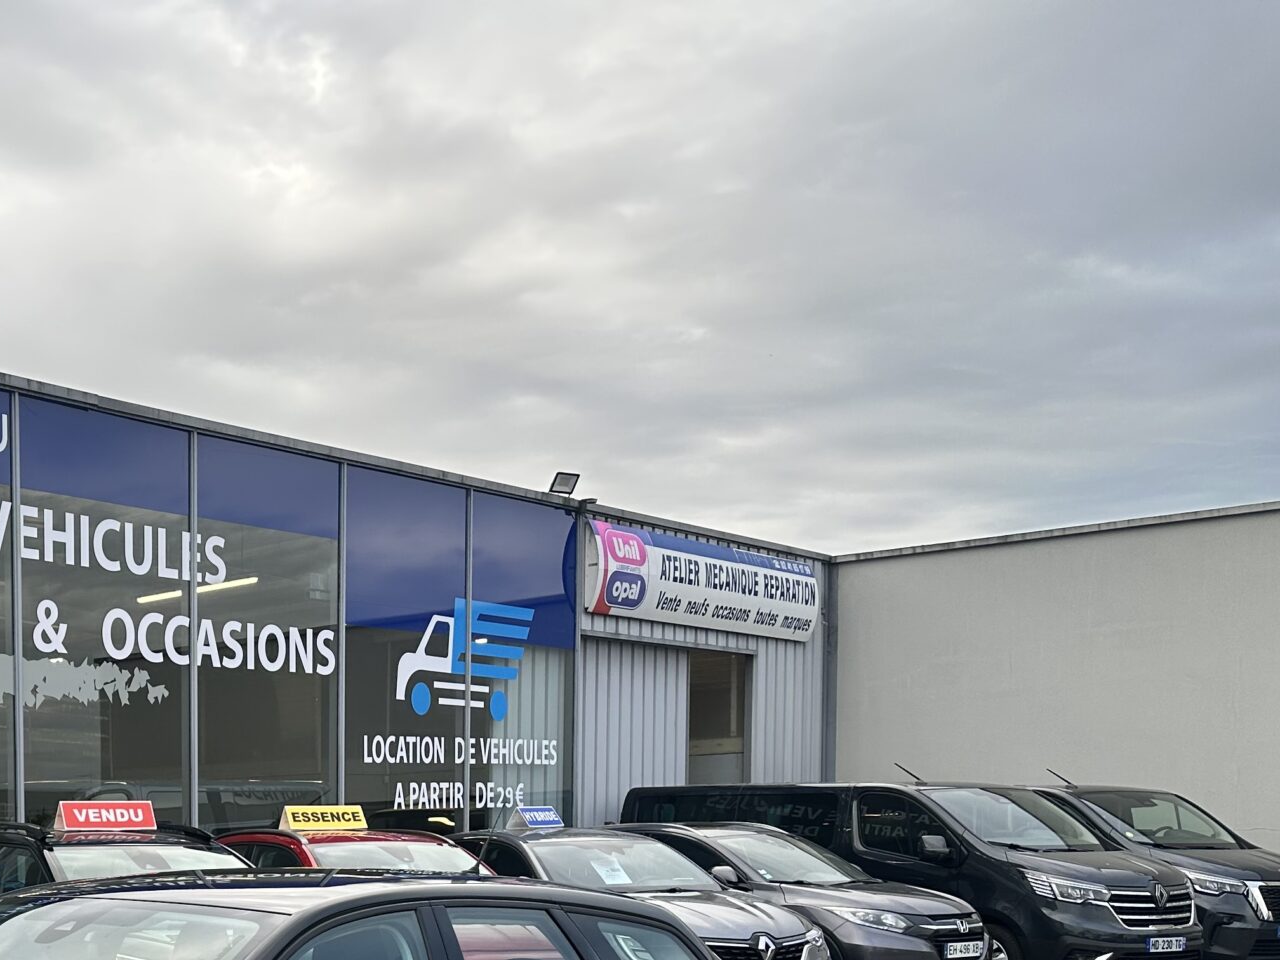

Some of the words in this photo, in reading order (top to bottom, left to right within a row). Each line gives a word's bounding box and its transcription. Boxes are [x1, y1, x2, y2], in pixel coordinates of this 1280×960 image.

[612, 536, 641, 561] Unil
[612, 580, 642, 603] opal
[660, 554, 700, 587] ATELIER
[705, 562, 758, 596] MECANIQUE
[763, 574, 816, 606] REPARATION
[655, 590, 681, 613] Vente
[684, 598, 710, 616] neufs
[711, 604, 751, 622] occasions
[753, 608, 779, 627] toutes
[780, 614, 813, 634] marques
[32, 599, 68, 654] &
[101, 608, 336, 676] OCCASIONS
[363, 735, 445, 764] LOCATION
[454, 737, 476, 765] DE
[480, 738, 558, 766] VEHICULES
[393, 782, 406, 810] A
[409, 782, 464, 809] PARTIR
[475, 782, 495, 808] DE
[72, 806, 144, 823] VENDU
[291, 811, 363, 824] ESSENCE
[522, 809, 559, 822] HYBRIDE
